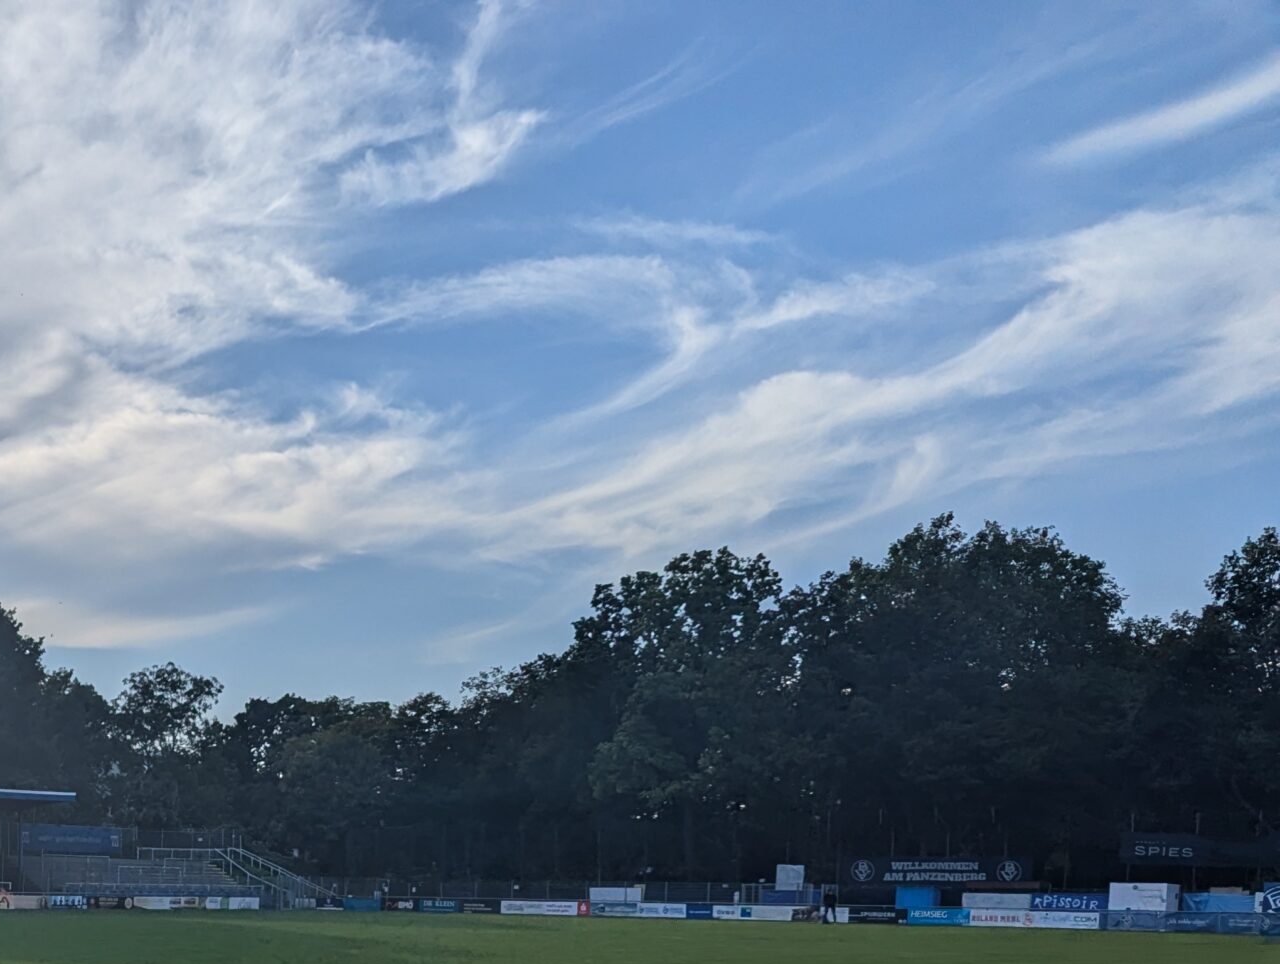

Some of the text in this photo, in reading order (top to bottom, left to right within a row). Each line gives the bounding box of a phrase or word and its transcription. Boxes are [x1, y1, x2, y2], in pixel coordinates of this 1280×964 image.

[1135, 846, 1193, 857] SPIES
[891, 862, 979, 870] WILLKOMMEN
[883, 873, 986, 881] AM PANZENBERG
[911, 910, 947, 918] HEIMSIEG
